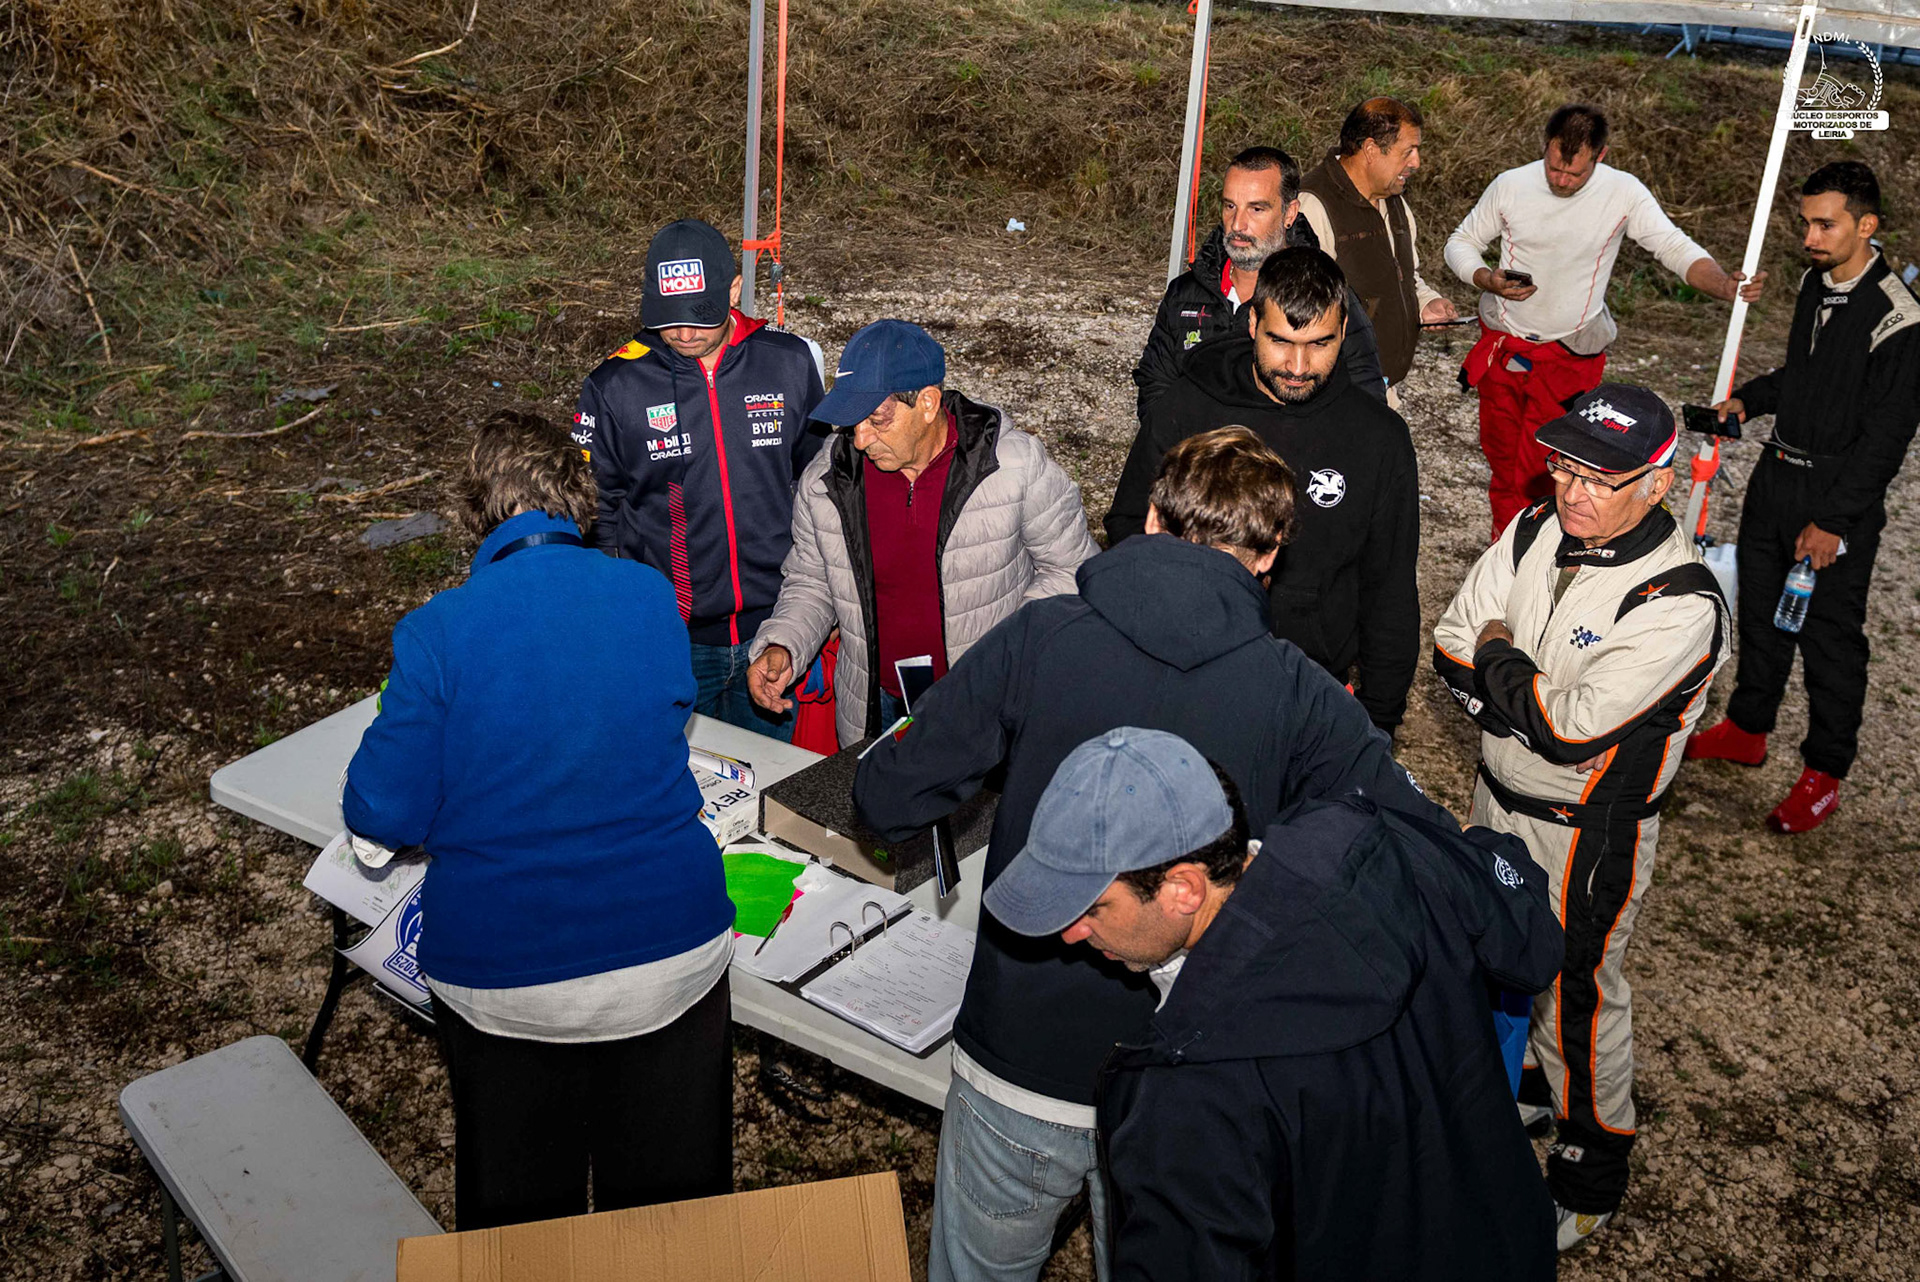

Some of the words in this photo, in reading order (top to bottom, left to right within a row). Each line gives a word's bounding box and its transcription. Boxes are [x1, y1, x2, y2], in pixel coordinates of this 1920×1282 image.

[661, 263, 699, 278] LIQUI
[662, 276, 700, 292] MOLY
[744, 393, 784, 403] ORACLE
[650, 406, 675, 418] TAG
[573, 412, 596, 428] obil
[752, 419, 782, 434] BYBIT
[646, 435, 680, 451] Mobil
[650, 446, 692, 460] ORACLE
[710, 788, 751, 812] REY
[392, 955, 420, 976] 2025
